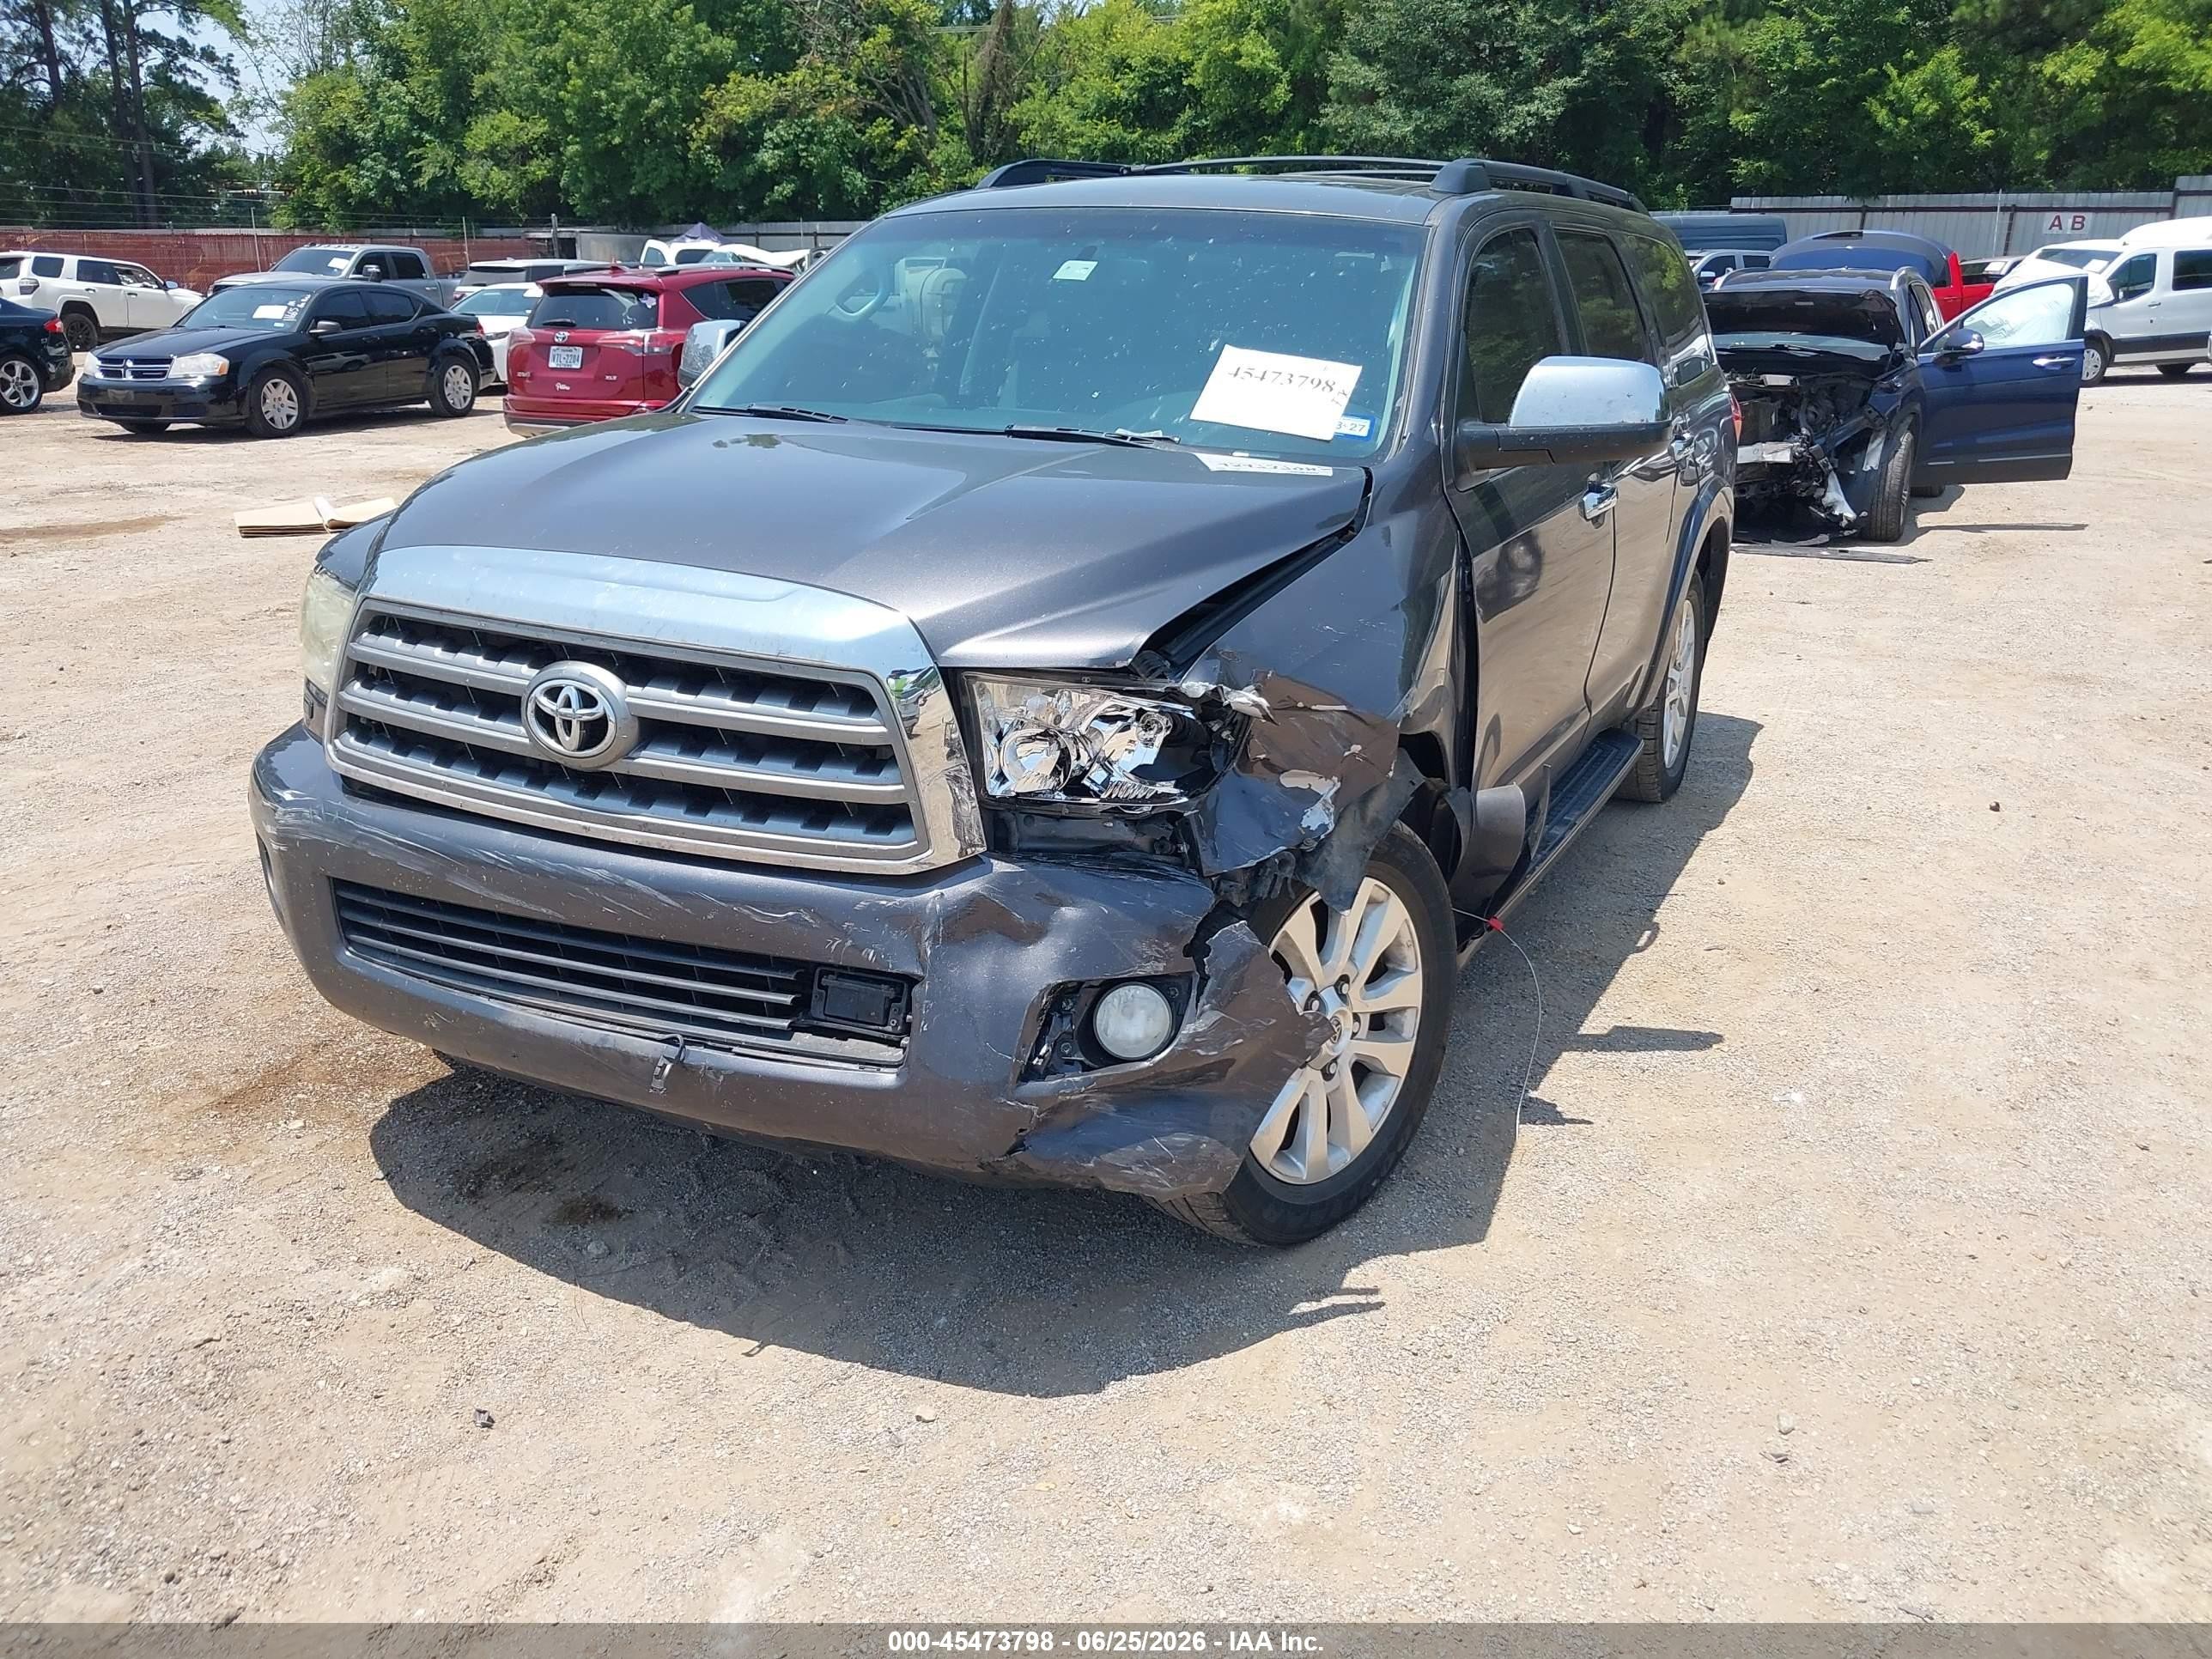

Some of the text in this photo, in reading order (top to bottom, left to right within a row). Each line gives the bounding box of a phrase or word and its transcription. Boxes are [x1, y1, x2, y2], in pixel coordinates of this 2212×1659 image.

[2049, 215, 2086, 230] A B
[1228, 366, 1336, 393] 45473798
